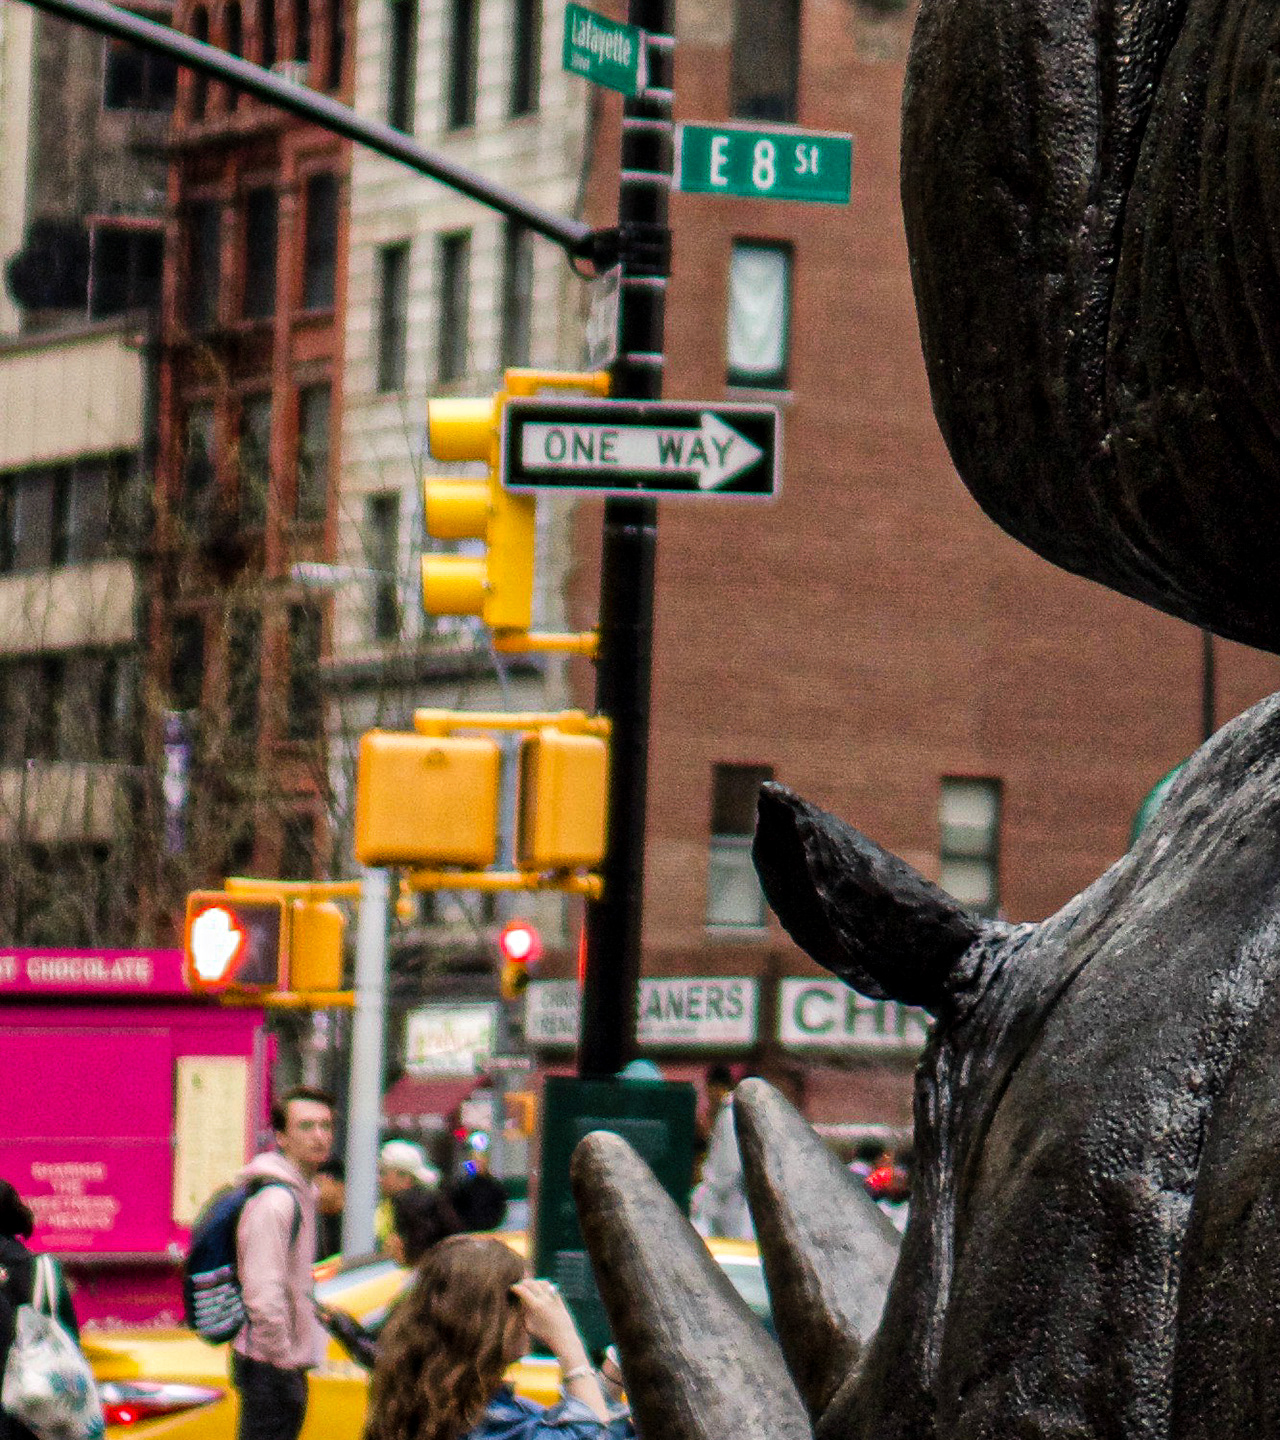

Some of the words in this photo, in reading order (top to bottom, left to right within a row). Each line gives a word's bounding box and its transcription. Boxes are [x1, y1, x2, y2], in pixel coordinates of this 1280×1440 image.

[571, 10, 632, 67] Lafayette
[710, 136, 730, 187] E
[752, 139, 776, 190] 8
[794, 143, 819, 175] St
[544, 429, 619, 464] ONE
[657, 433, 735, 469] WAY
[27, 956, 151, 985] CHOCOLATE
[644, 984, 745, 1020] ANERS
